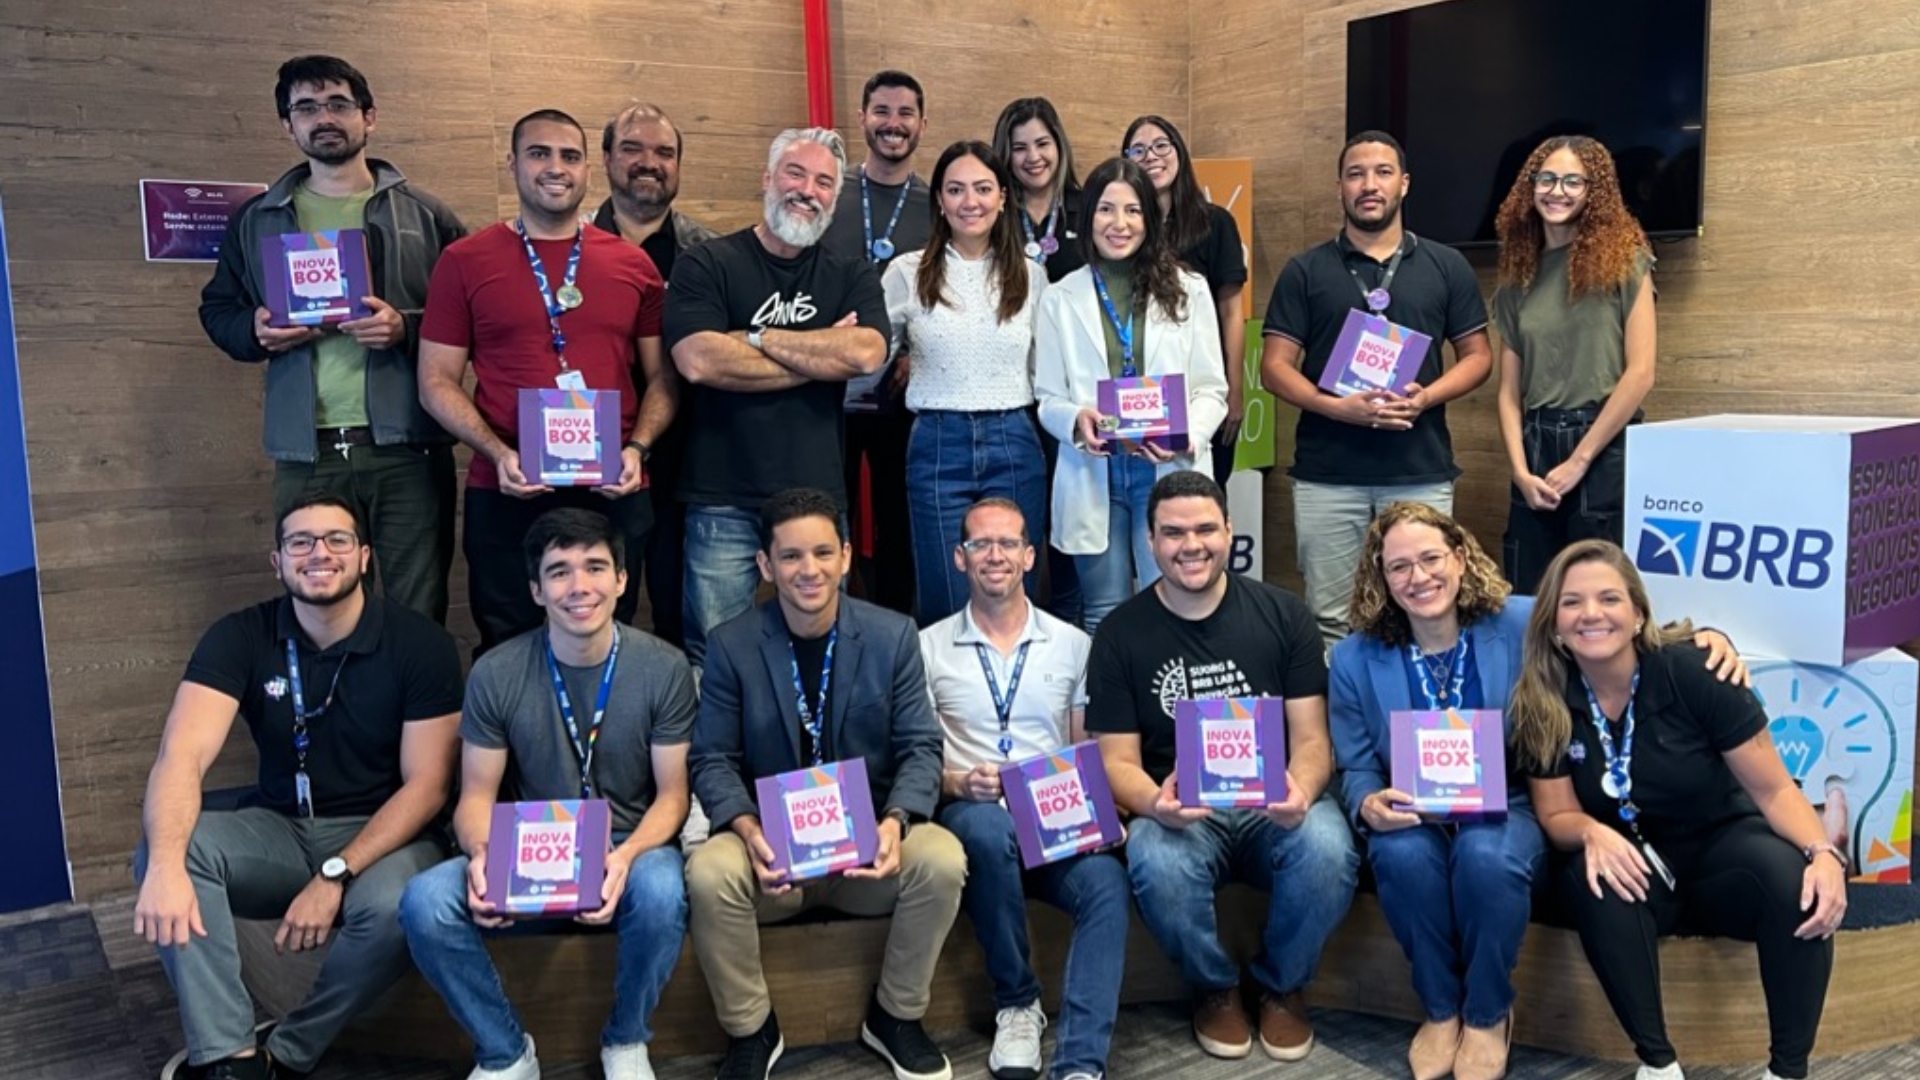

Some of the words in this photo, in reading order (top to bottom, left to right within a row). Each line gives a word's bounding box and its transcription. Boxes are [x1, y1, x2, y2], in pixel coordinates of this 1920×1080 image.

[293, 257, 336, 270] INOVA
[293, 268, 337, 286] BOX
[1360, 339, 1396, 360] INOVA
[1354, 349, 1391, 373] BOX
[1121, 400, 1160, 411] BOX
[1122, 392, 1159, 403] INOVA
[548, 417, 591, 428] INOVA
[548, 429, 592, 444] BOX
[1643, 494, 1704, 514] banco
[1849, 484, 1920, 539] CONEXÃ
[1702, 521, 1834, 590] BRB
[1226, 659, 1237, 671] &
[1191, 677, 1214, 689] BRB
[1214, 673, 1235, 686] LAB
[1236, 670, 1246, 682] &
[1242, 682, 1252, 693] &
[1207, 730, 1252, 741] INOVA
[1422, 739, 1470, 749] INOVA
[1207, 743, 1252, 760] BOX
[1422, 751, 1470, 767] BOX
[1036, 779, 1079, 800] INOVA
[791, 793, 838, 813] INOVA
[1039, 791, 1084, 818] BOX
[793, 806, 841, 832] BOX
[522, 831, 571, 845] INOVA
[520, 845, 571, 864] BOX
